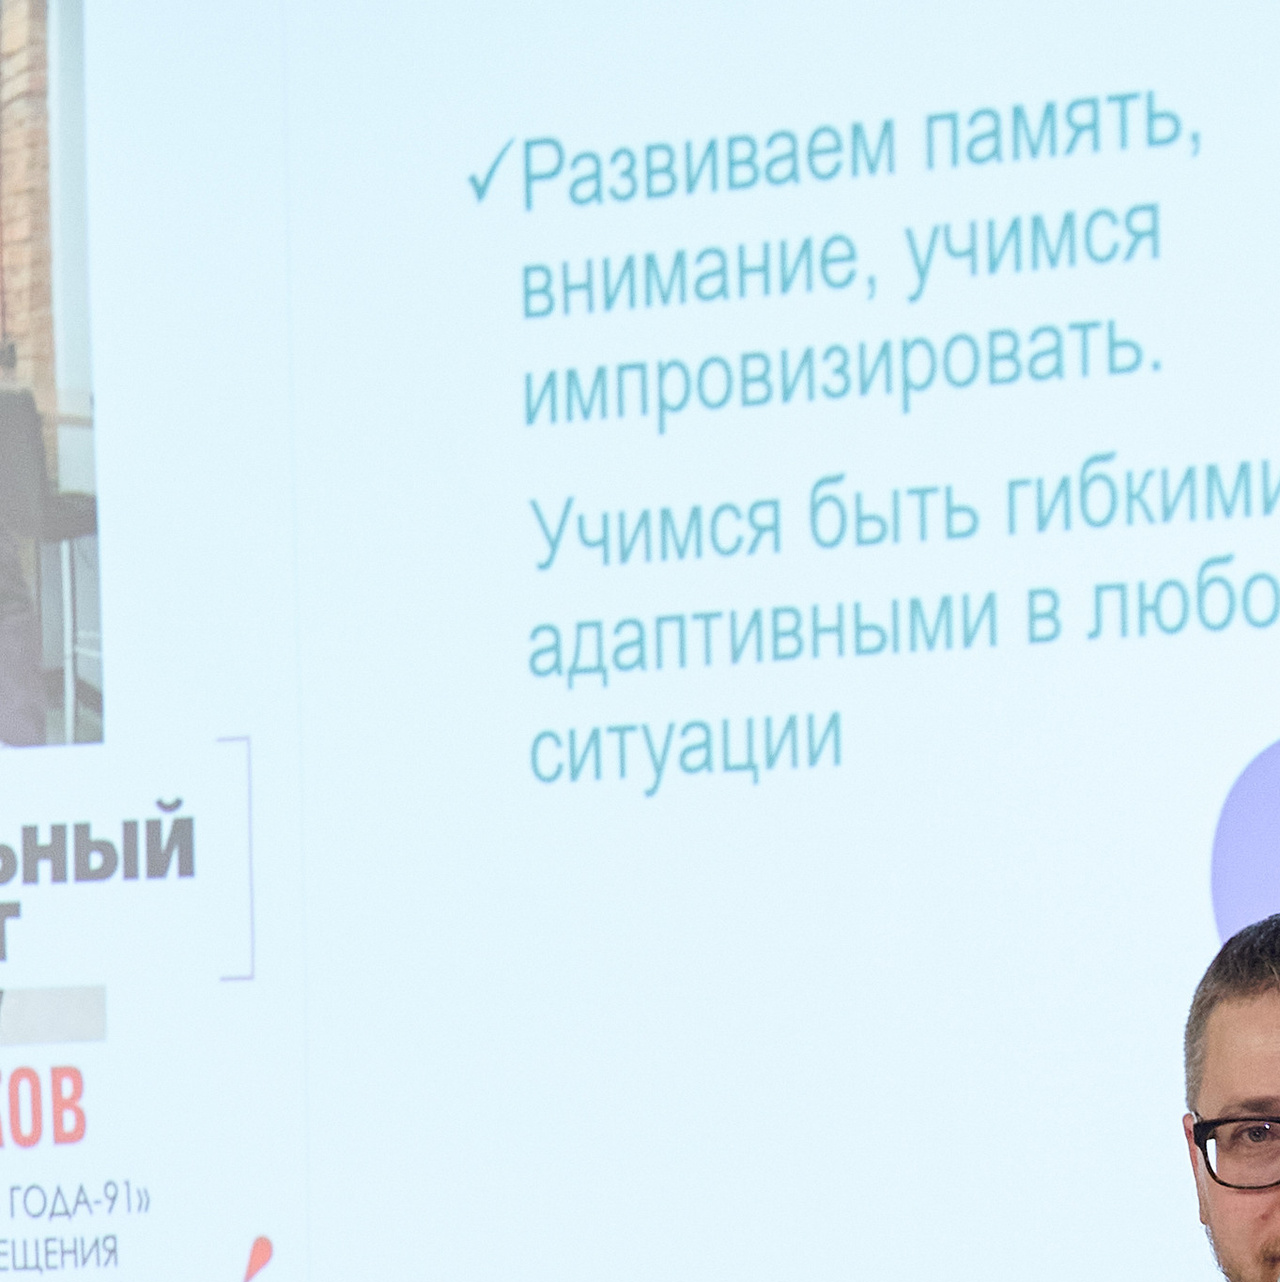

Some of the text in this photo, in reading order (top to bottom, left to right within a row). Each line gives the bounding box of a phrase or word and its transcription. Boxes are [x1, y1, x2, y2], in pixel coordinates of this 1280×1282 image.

[522, 89, 1202, 213] Развиваем память,
[521, 201, 1161, 320] внимание, учимся
[523, 318, 1163, 436] импровизировать.
[528, 497, 783, 572] Учимся
[808, 471, 981, 550] быть
[528, 591, 998, 691] адаптивными
[1027, 586, 1063, 645] в
[529, 710, 842, 799] ситуации
[0, 1065, 88, 1150] ОВ
[9, 1179, 151, 1222] ГОДА-91»
